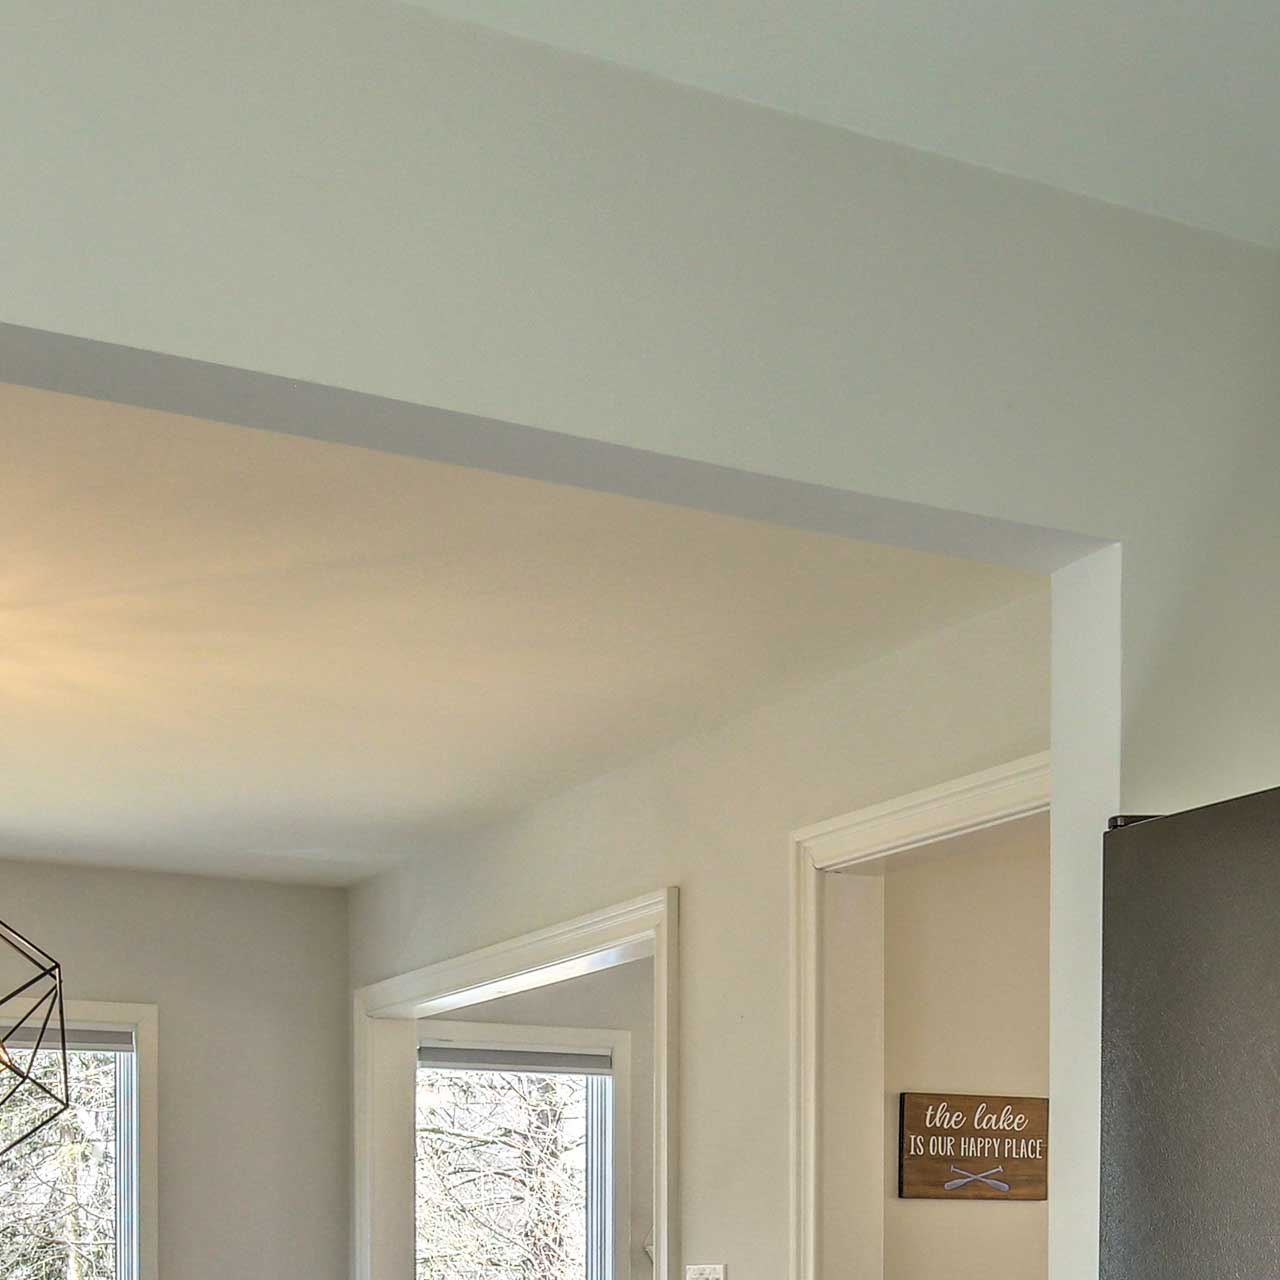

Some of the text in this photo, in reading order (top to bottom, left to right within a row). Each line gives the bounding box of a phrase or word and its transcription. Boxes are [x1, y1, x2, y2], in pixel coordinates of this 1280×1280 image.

[925, 1102, 1029, 1132] the lake
[909, 1135, 1043, 1159] IS OUR HAPPY PLACE
